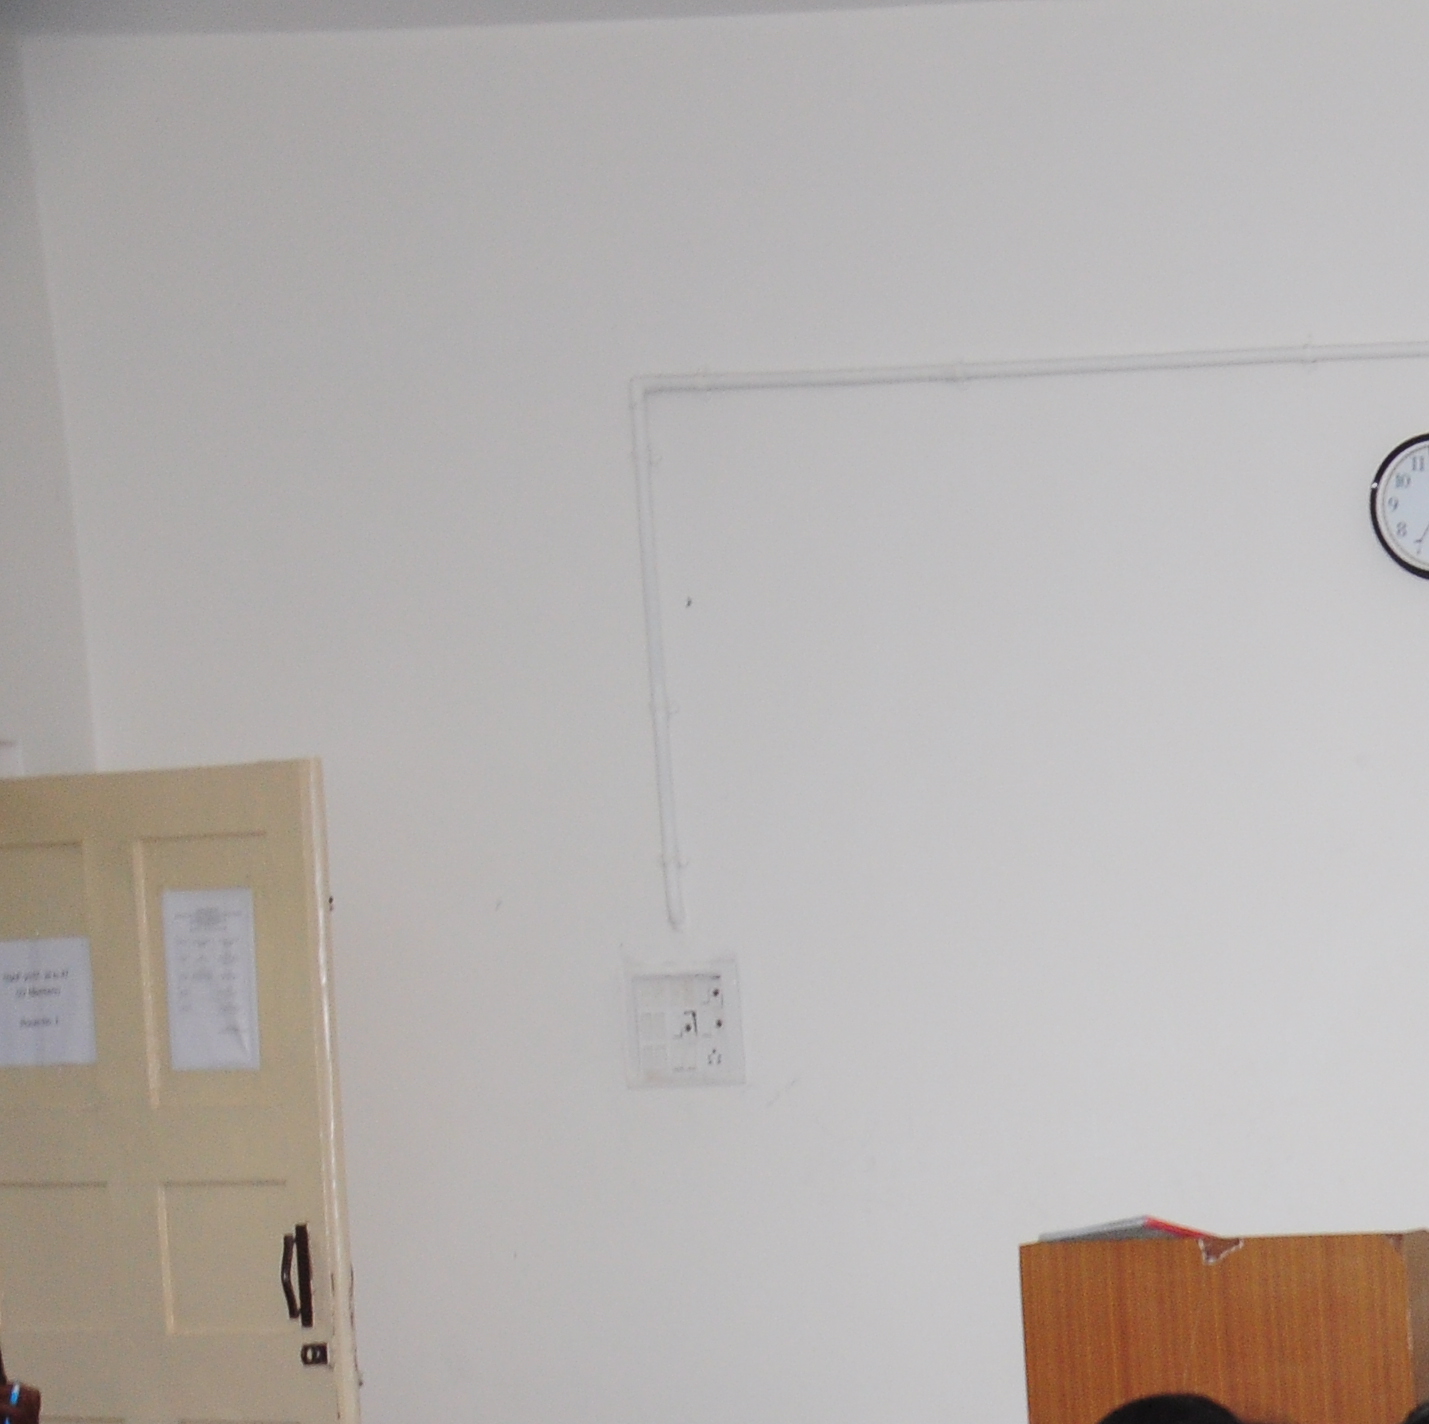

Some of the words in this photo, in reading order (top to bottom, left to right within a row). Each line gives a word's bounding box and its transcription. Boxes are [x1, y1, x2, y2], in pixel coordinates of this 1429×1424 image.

[1411, 455, 1425, 472] 11
[1395, 473, 1411, 489] 10
[1387, 496, 1399, 512] 9
[1396, 521, 1407, 538] 8
[1413, 538, 1422, 555] 7
